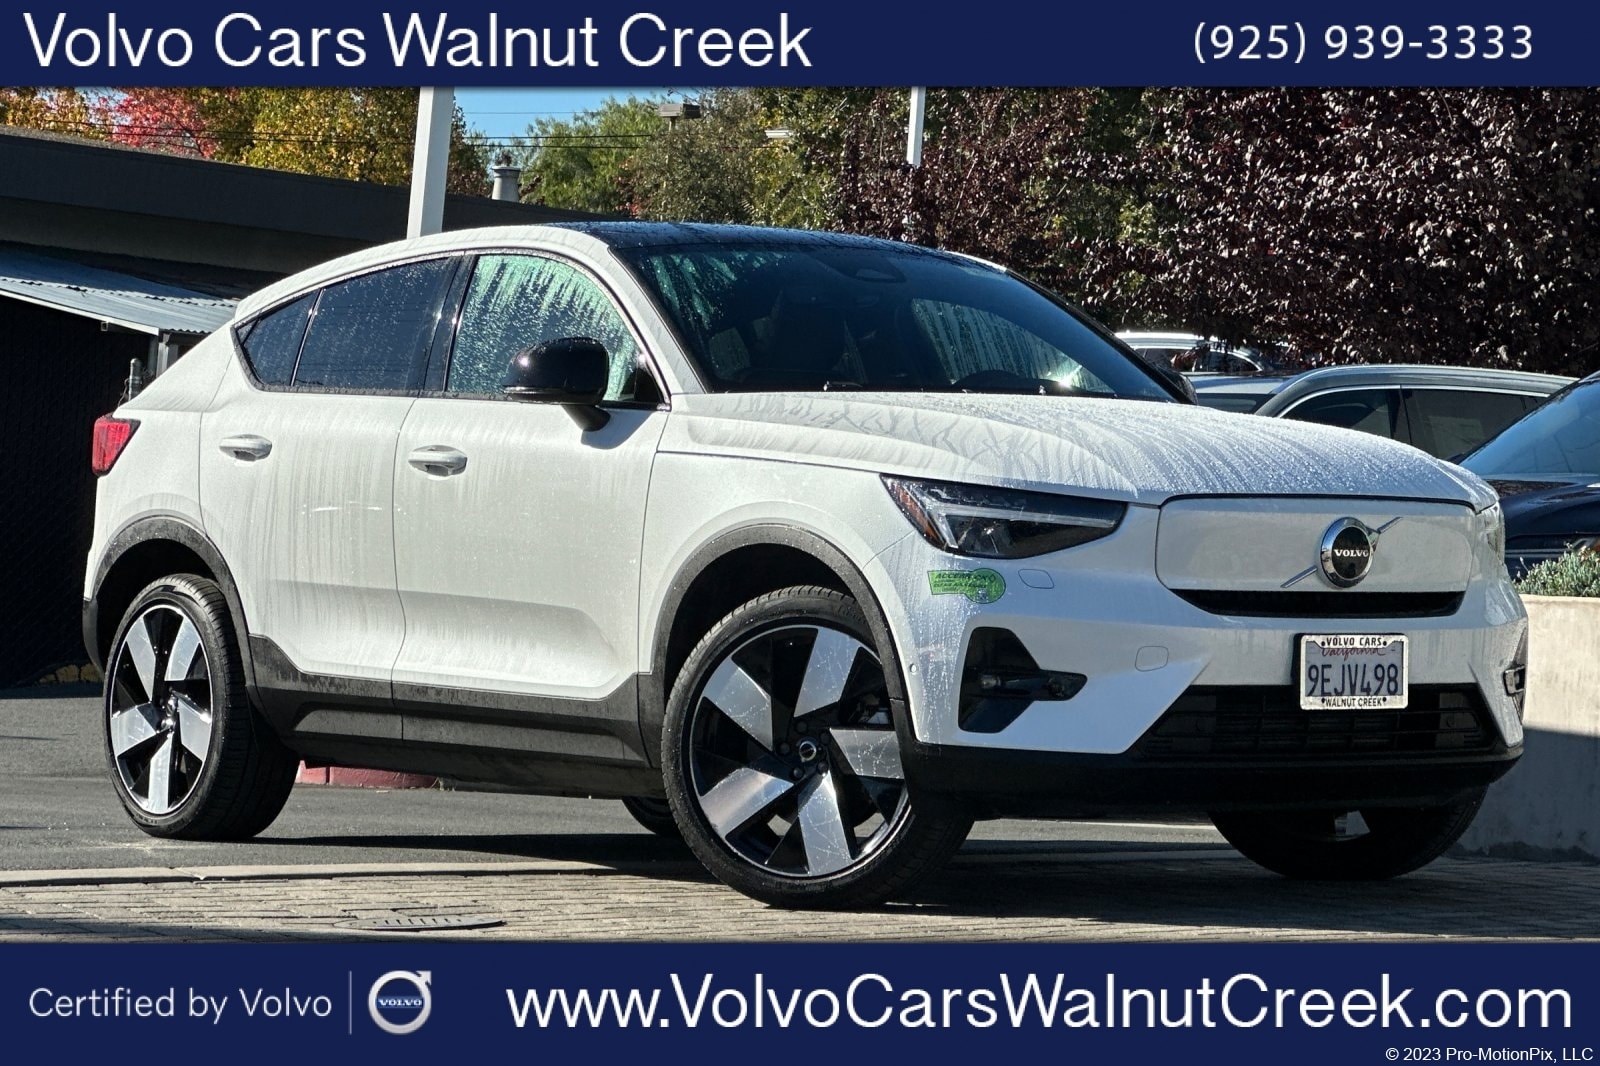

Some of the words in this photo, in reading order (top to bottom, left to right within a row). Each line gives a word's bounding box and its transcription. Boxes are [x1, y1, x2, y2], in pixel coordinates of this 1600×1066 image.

[1333, 548, 1370, 558] VOLVO
[1326, 637, 1355, 646] VOLVO
[1359, 637, 1382, 646] CARS
[1307, 663, 1399, 697] 9EJV498
[1325, 697, 1356, 707] WALNUT
[1358, 697, 1382, 707] CREEK
